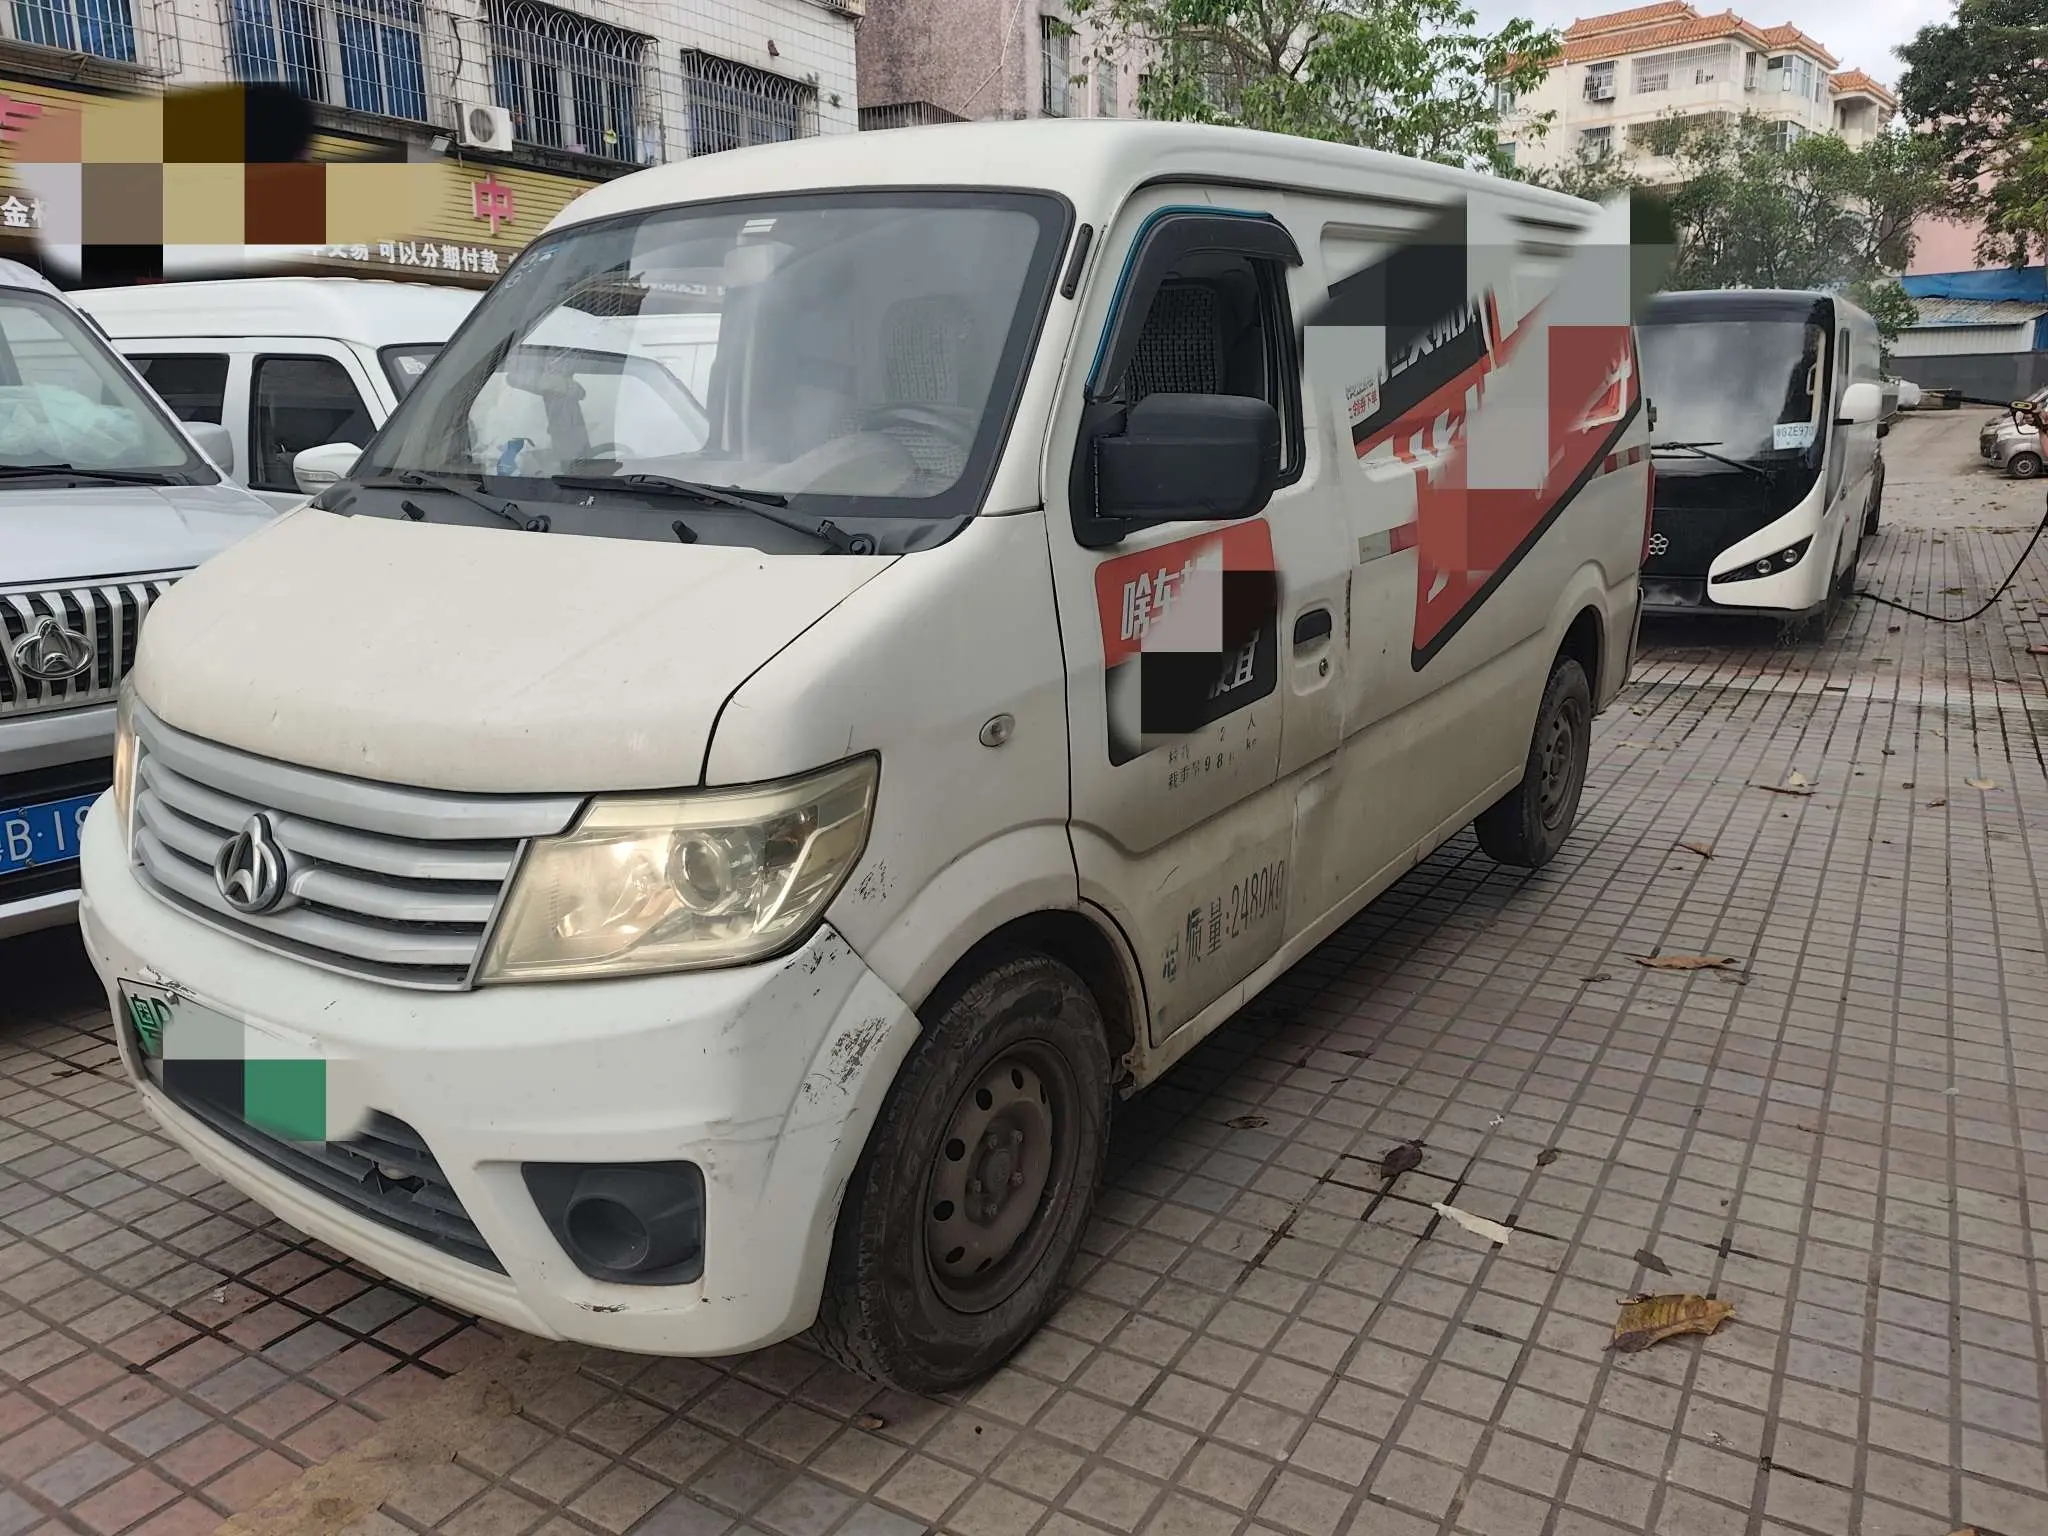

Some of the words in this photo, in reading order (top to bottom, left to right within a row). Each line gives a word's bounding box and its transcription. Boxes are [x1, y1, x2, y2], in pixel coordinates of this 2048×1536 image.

[472, 172, 513, 237] 中
[377, 239, 500, 275] 可以分期付款
